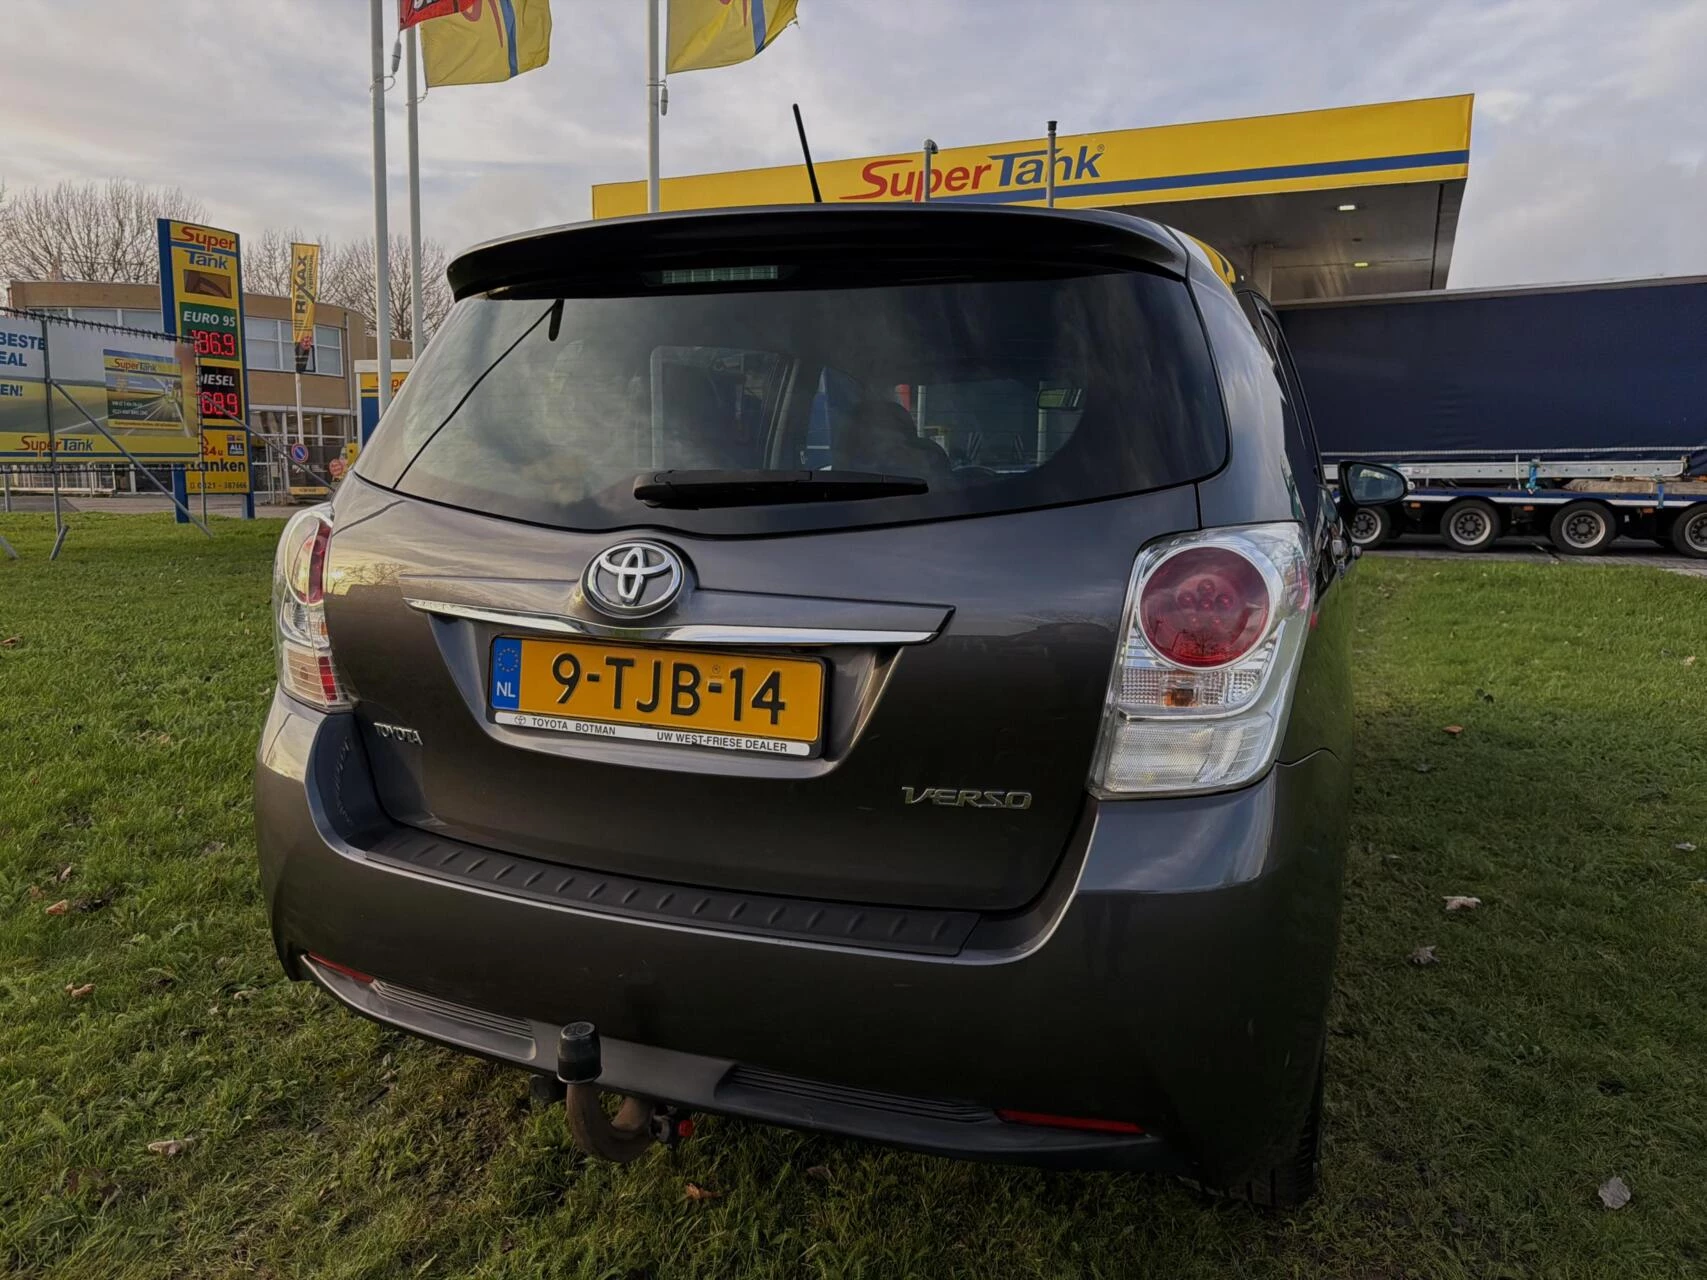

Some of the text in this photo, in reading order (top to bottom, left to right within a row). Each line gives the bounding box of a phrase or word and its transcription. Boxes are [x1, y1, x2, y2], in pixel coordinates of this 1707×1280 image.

[171, 226, 236, 252] Super
[184, 249, 228, 271] Tank
[183, 310, 236, 329] EURO 95
[496, 681, 516, 698] NL
[551, 651, 786, 725] 9-TJB-14
[373, 722, 424, 747] TOYOTA
[532, 717, 787, 753] TOYOTA BOTMAN UW WEST-FRIESE DEALER
[901, 786, 1033, 810] VERSO
